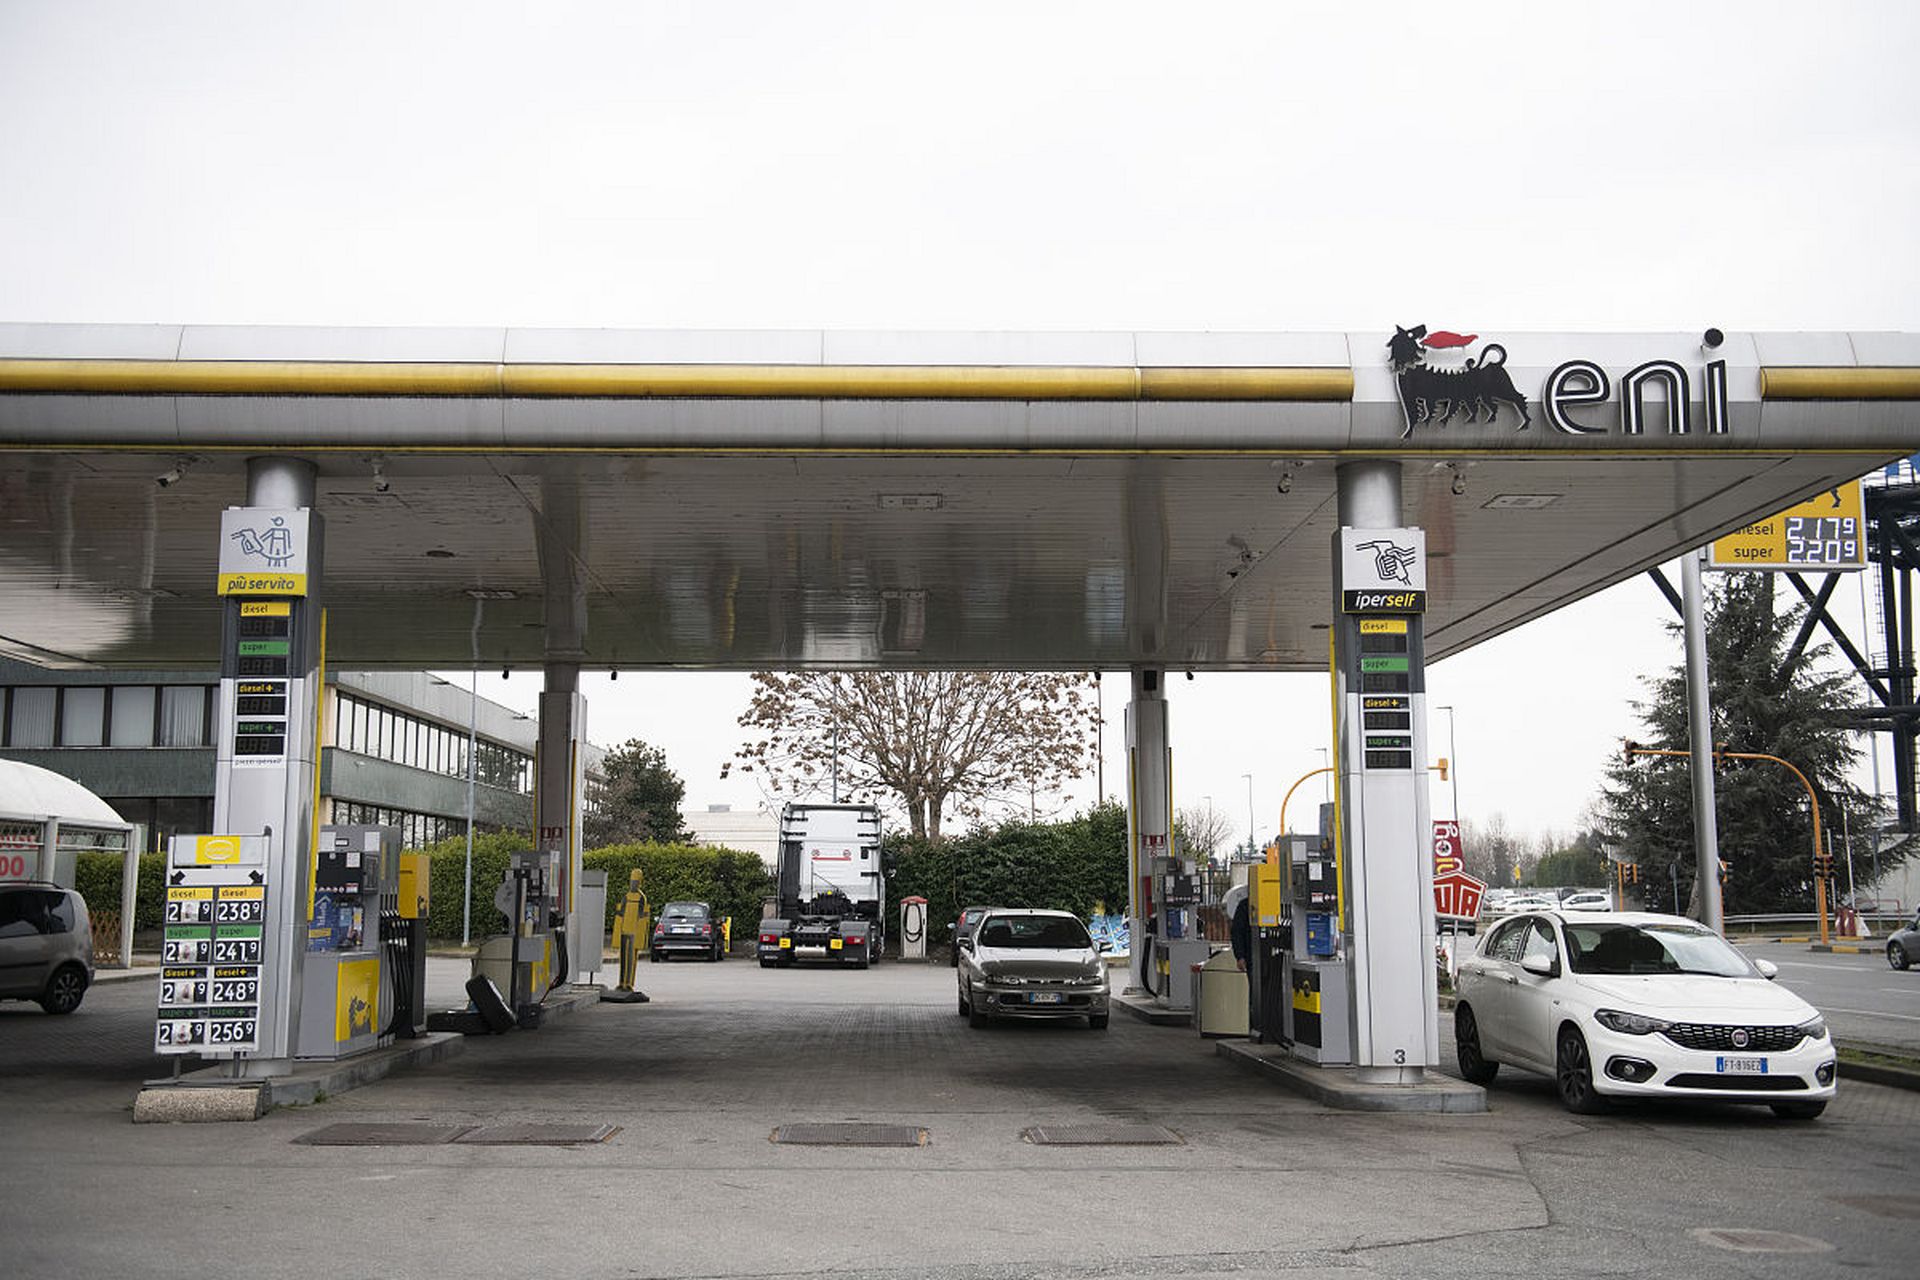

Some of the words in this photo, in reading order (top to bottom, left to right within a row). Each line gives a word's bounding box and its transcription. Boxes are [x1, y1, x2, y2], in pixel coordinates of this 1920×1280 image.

[1543, 328, 1731, 436] eni
[1734, 548, 1774, 561] super
[248, 577, 295, 590] servito
[1355, 591, 1416, 610] iperself
[243, 604, 268, 613] diesel
[1363, 622, 1388, 630] diesel
[170, 889, 196, 898] diesel
[221, 889, 247, 897] diesel
[1394, 1049, 1405, 1064] 3
